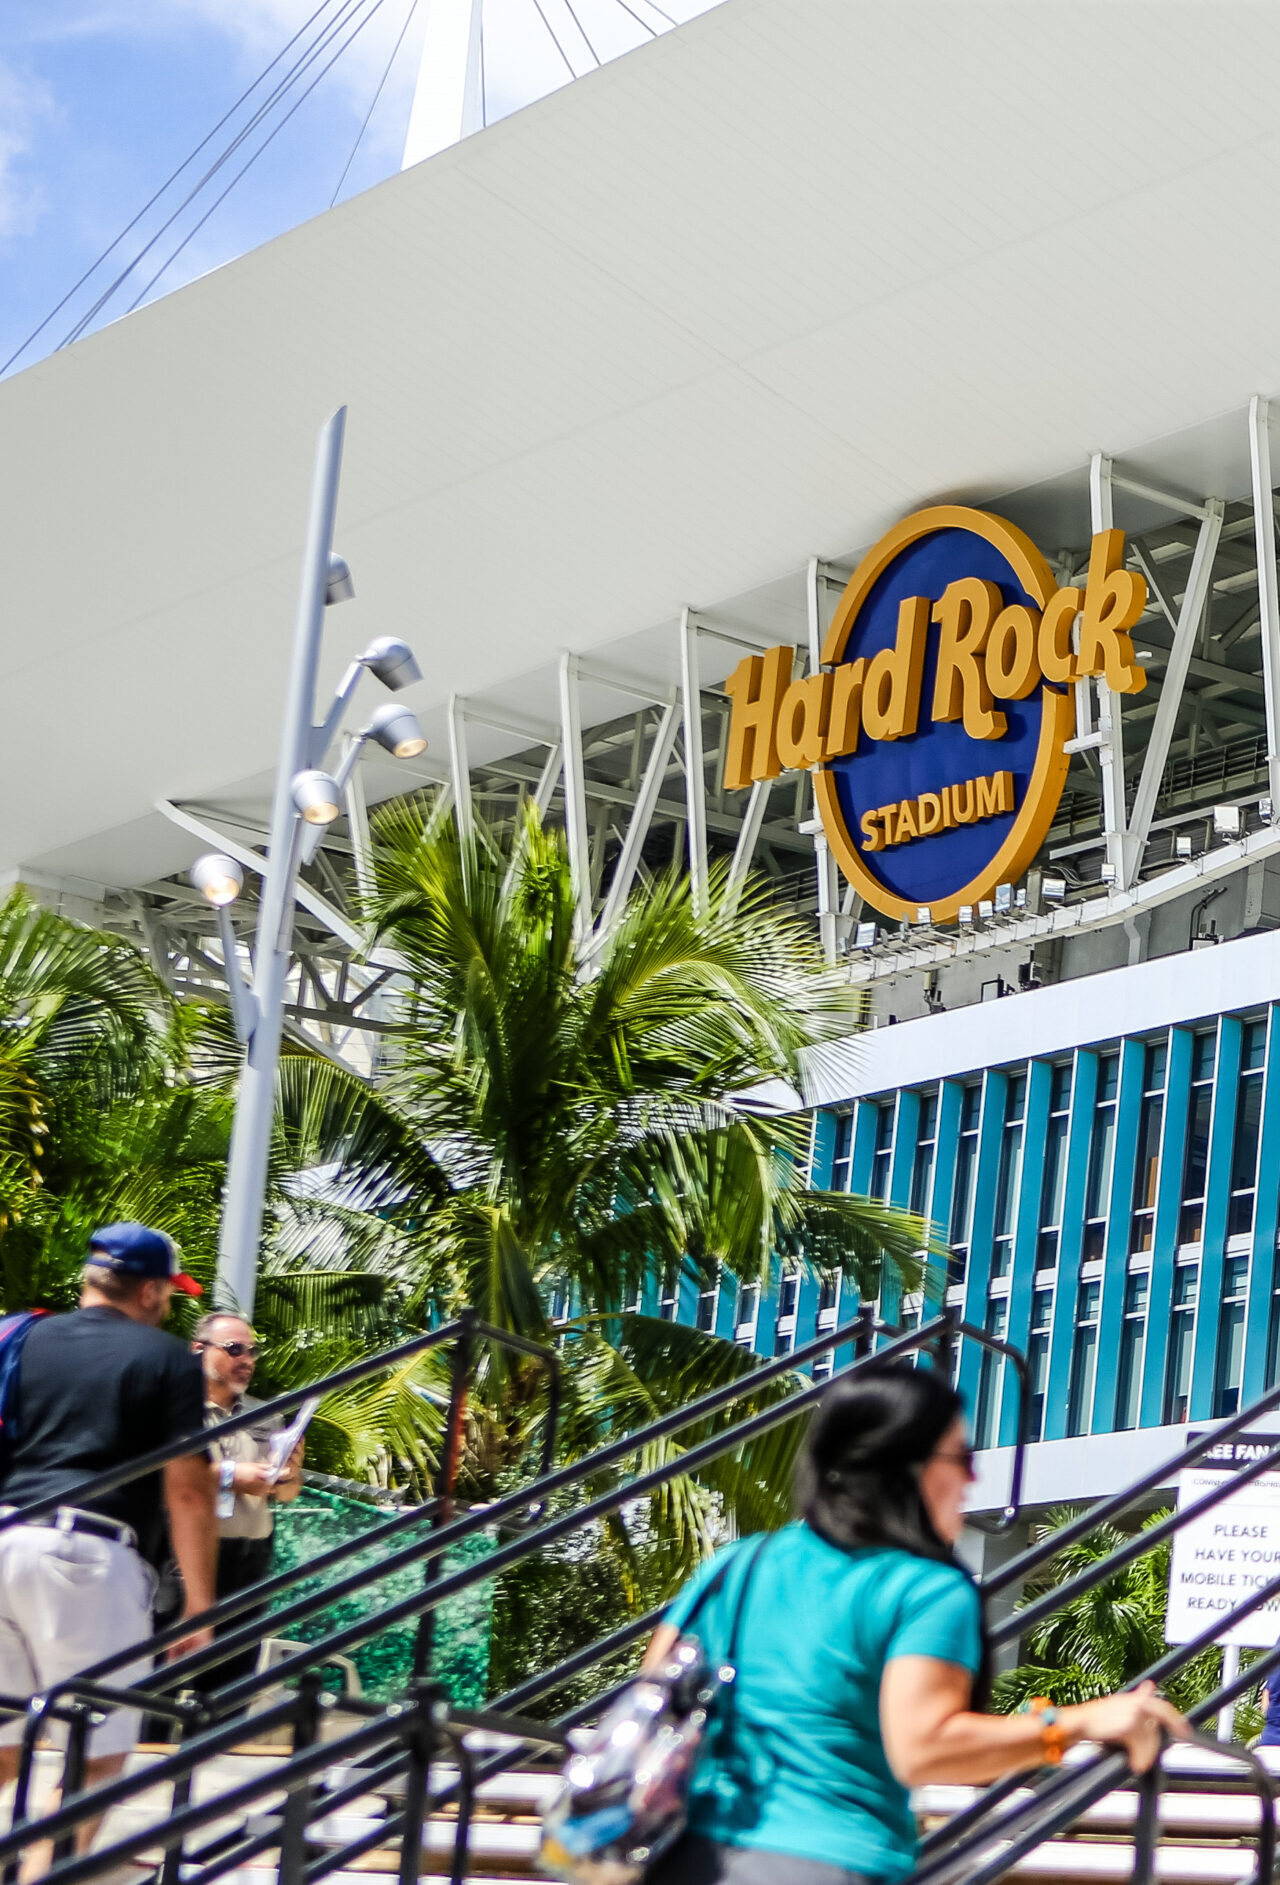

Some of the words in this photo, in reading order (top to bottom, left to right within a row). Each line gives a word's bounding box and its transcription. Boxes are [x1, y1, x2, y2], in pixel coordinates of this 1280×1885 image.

[724, 597, 929, 790] Hard
[931, 529, 1147, 739] Rock
[860, 771, 1014, 852] STADIUM
[1235, 1444, 1269, 1461] FAN
[1214, 1525, 1268, 1538] PLEASE
[1195, 1549, 1235, 1561] HAVE
[1181, 1573, 1237, 1586] MOBILE
[1188, 1597, 1237, 1611] READY
